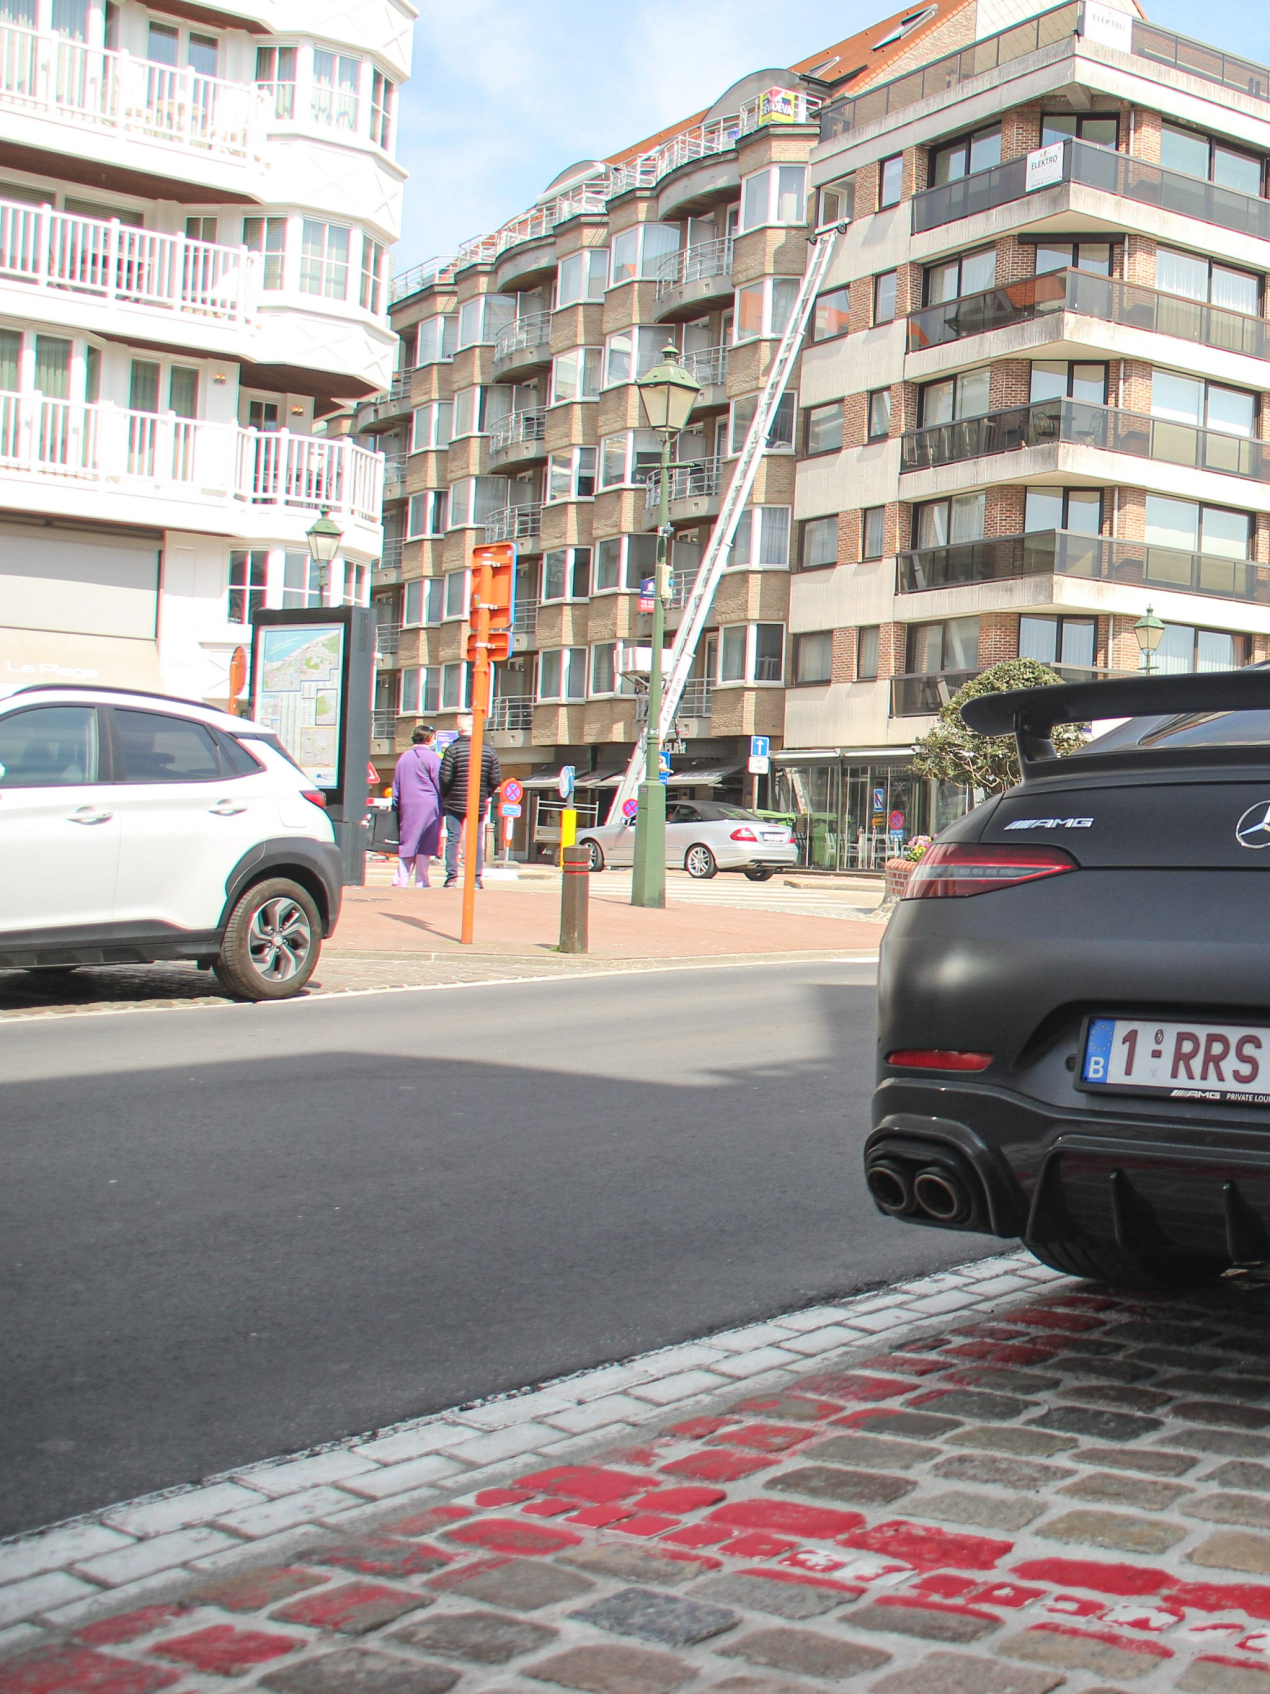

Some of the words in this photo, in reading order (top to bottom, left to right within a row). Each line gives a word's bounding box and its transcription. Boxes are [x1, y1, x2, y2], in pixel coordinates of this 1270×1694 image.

[1092, 13, 1126, 31] ELEKTRO
[1031, 154, 1058, 171] ELEKTRO
[7, 660, 36, 674] La
[1030, 817, 1094, 828] AMG
[1088, 1056, 1105, 1079] B
[1186, 1090, 1221, 1099] AMG
[1226, 1092, 1253, 1102] PRIVATE
